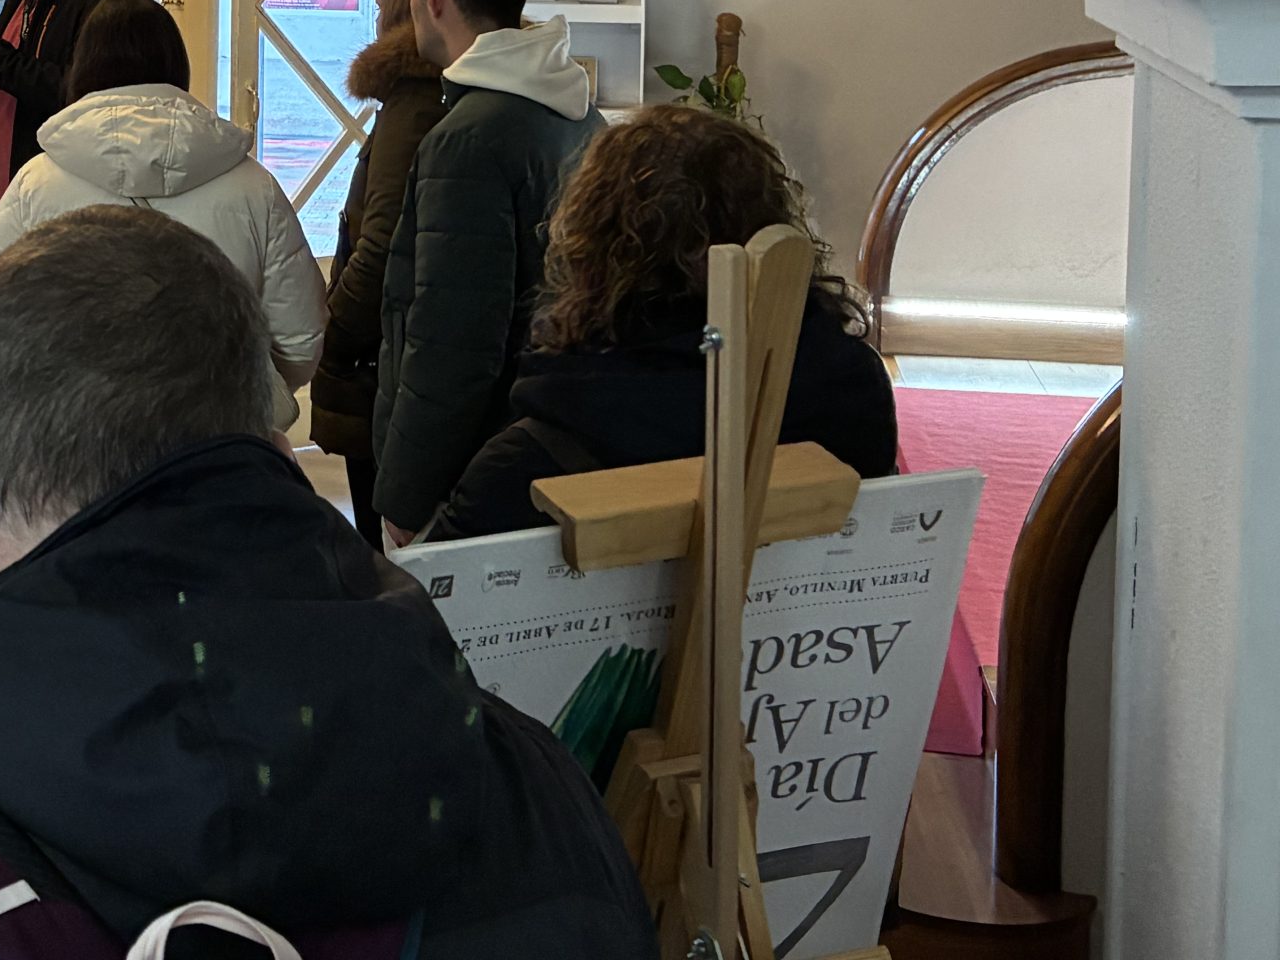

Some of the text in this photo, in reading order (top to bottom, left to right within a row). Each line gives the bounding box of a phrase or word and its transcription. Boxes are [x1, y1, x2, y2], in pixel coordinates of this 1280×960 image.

[589, 615, 612, 632] 17
[744, 619, 912, 692] Asad
[743, 693, 890, 754] del Aj
[768, 750, 878, 811] Día
